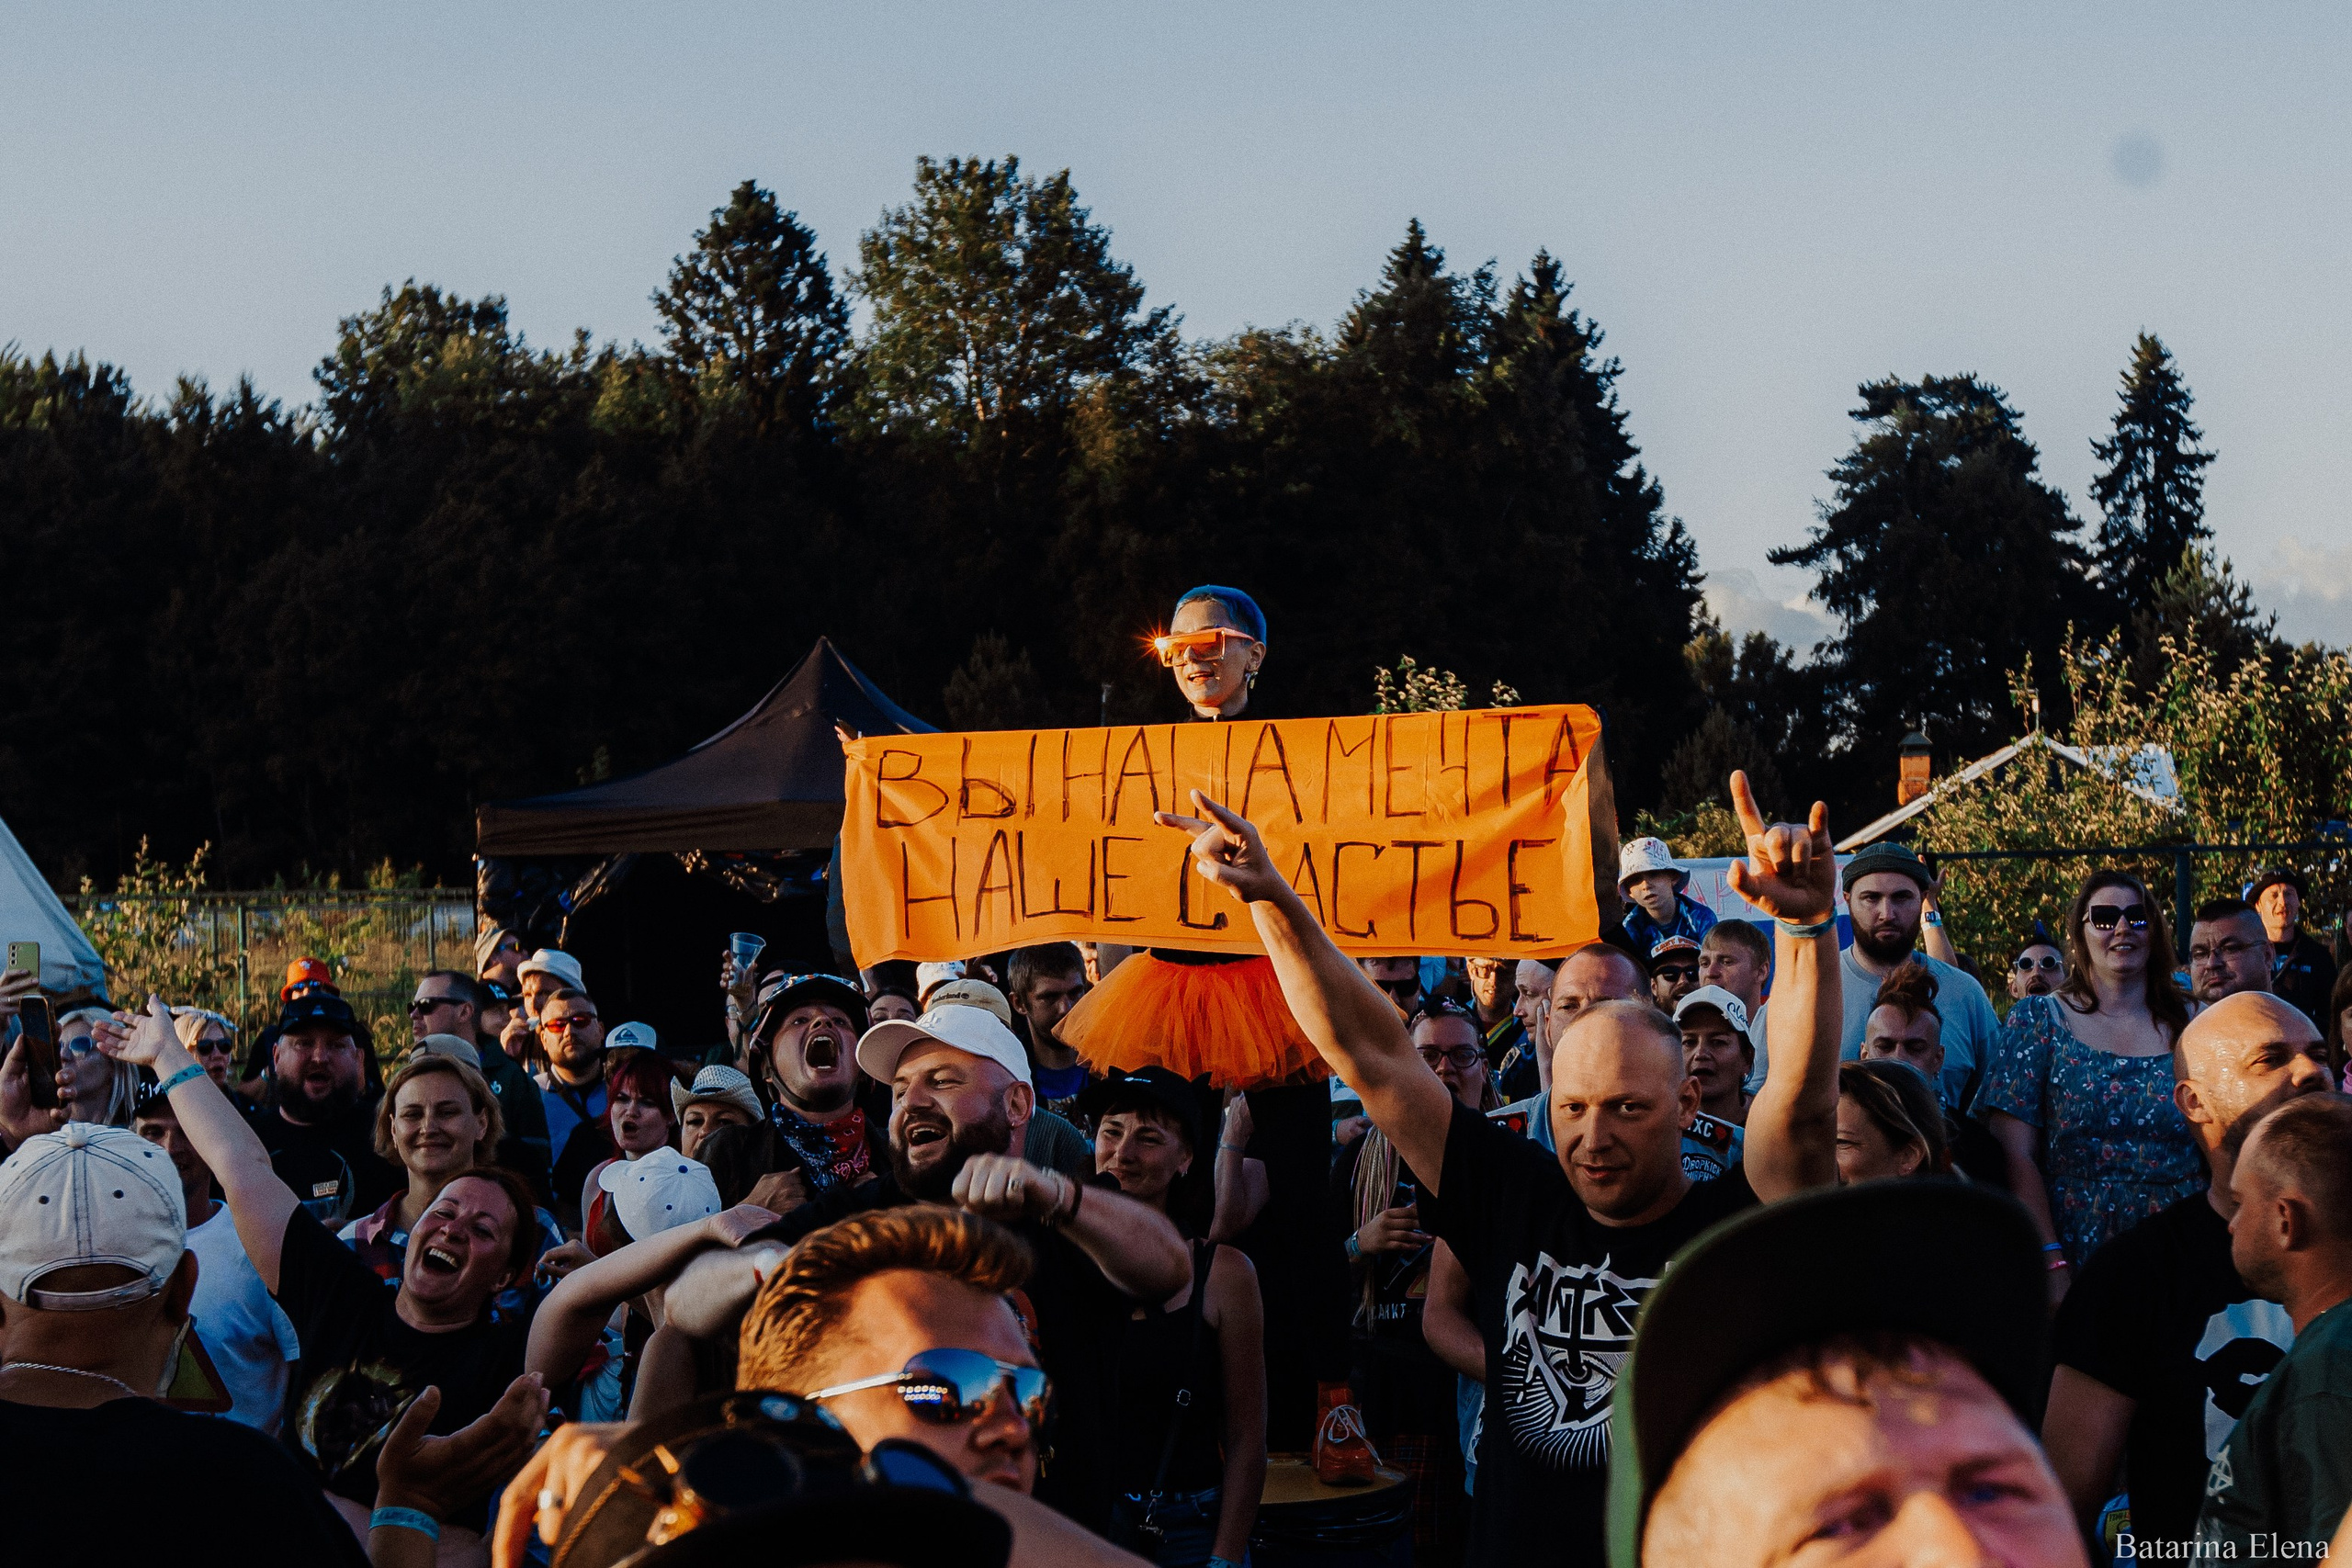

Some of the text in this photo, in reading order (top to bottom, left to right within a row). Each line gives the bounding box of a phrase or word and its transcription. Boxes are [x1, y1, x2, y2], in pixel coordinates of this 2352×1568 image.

[876, 737, 1037, 829] ВЫ
[1322, 712, 1579, 824] МЕЧТА
[900, 829, 1148, 942] НАШЕ
[1177, 838, 1556, 942] САСТЬЕ
